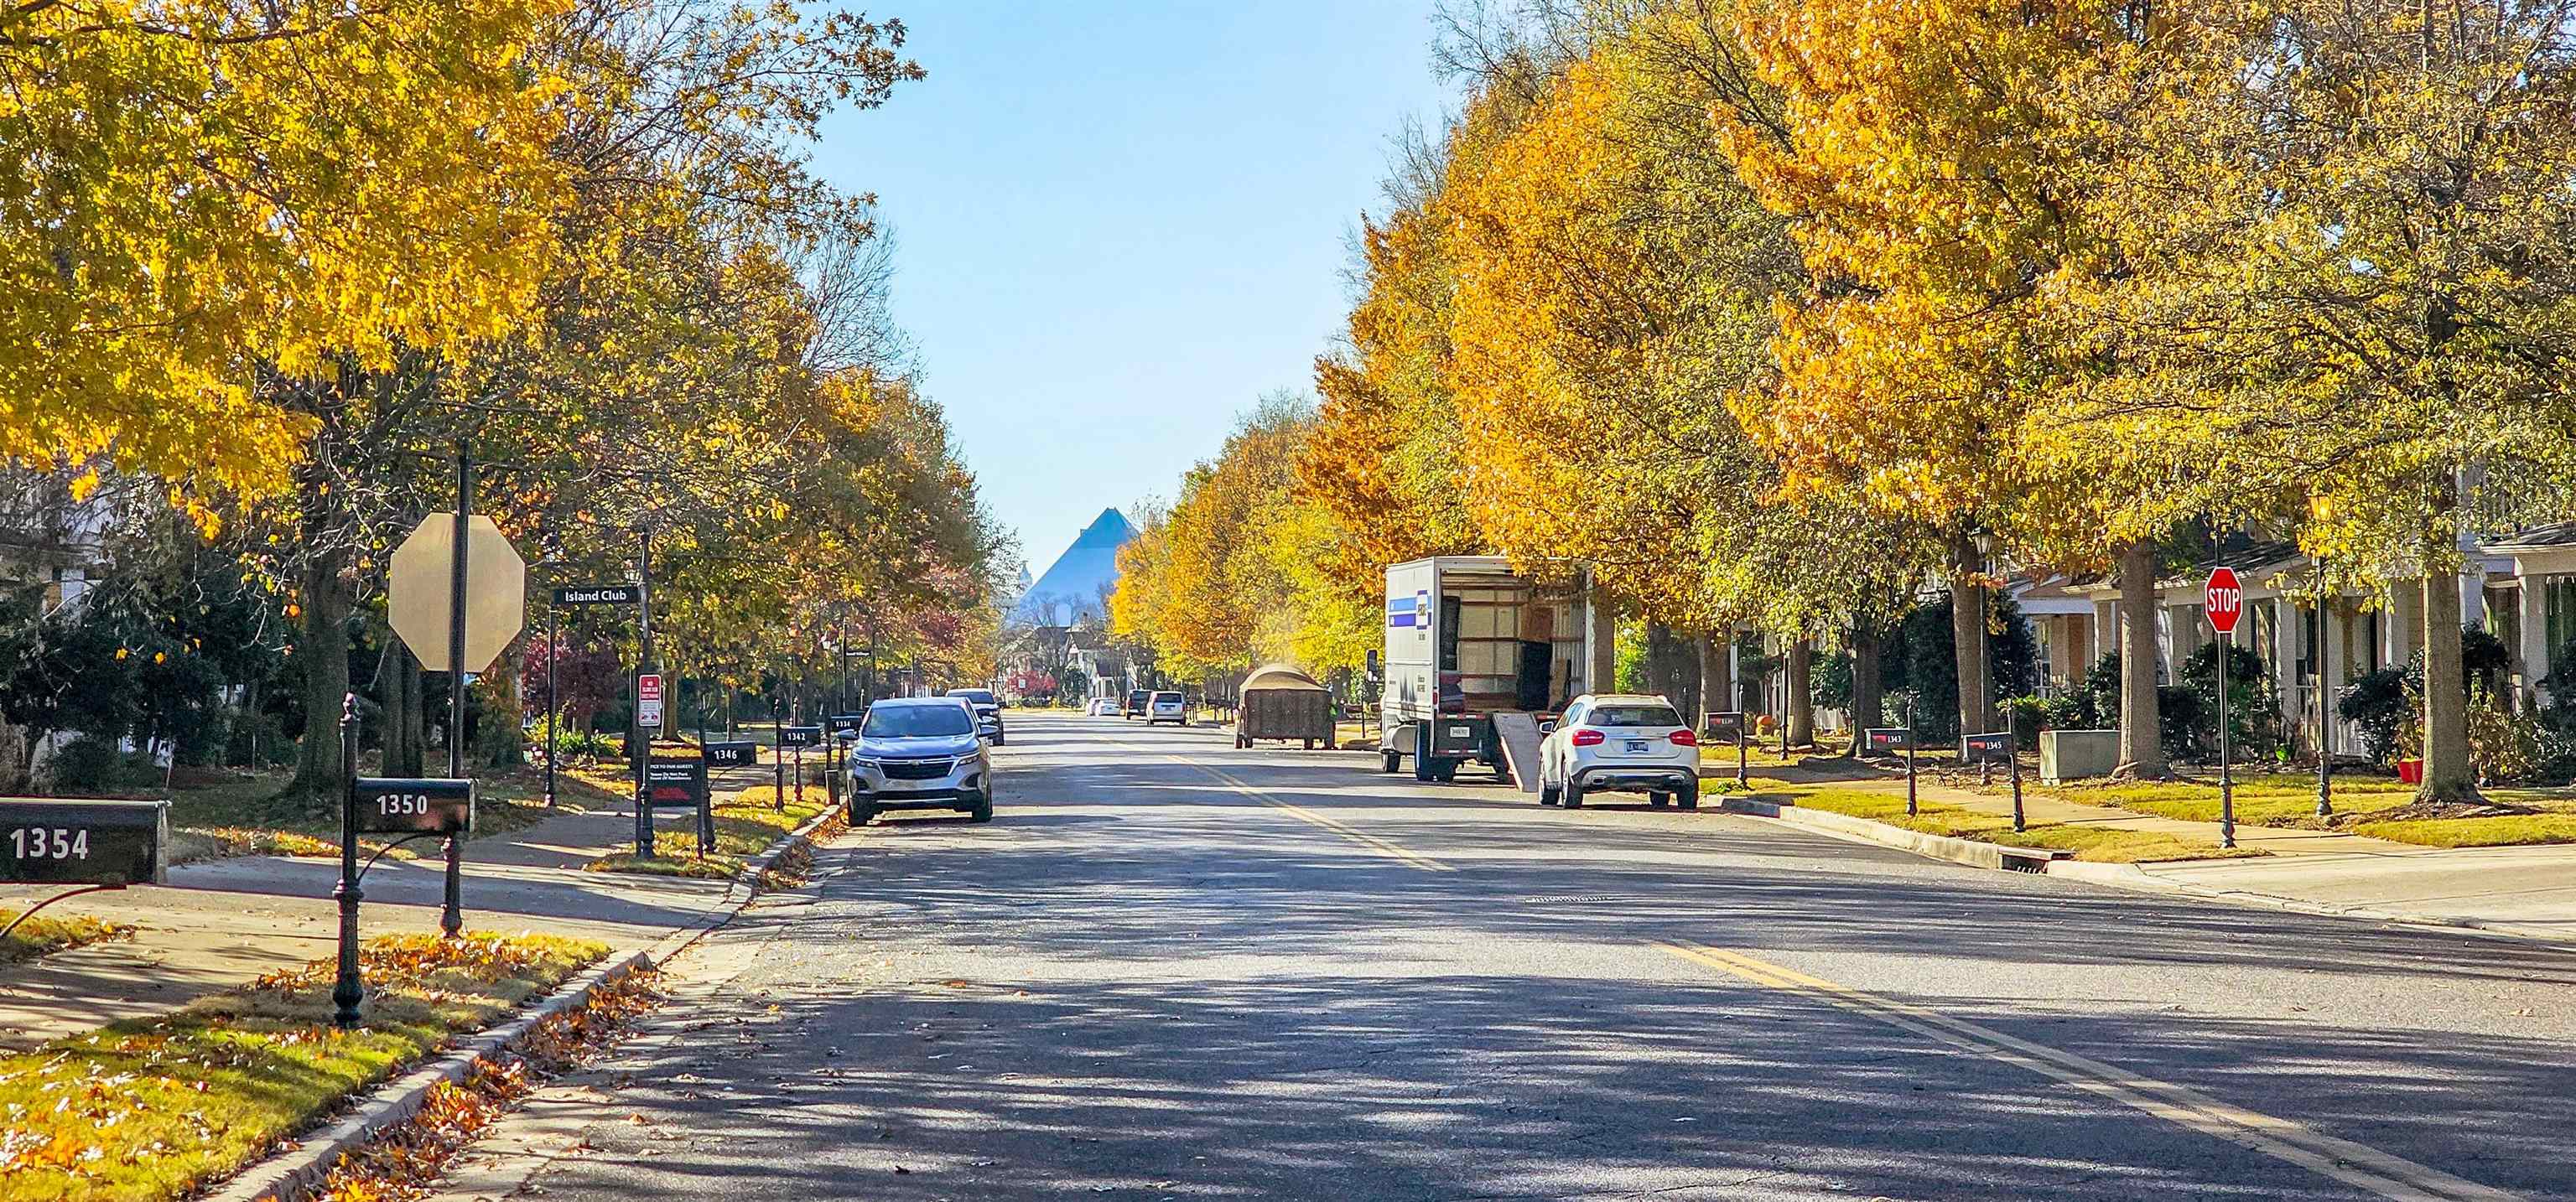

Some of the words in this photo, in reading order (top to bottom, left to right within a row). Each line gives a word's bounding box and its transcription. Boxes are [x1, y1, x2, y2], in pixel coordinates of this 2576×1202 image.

[565, 591, 599, 602] Island
[601, 590, 627, 600] Club
[2208, 588, 2240, 613] STOP
[788, 732, 806, 741] 1342
[1987, 741, 2002, 750] 1345
[714, 749, 737, 760] 1346
[377, 794, 428, 815] 1350
[9, 827, 88, 860] 1354
